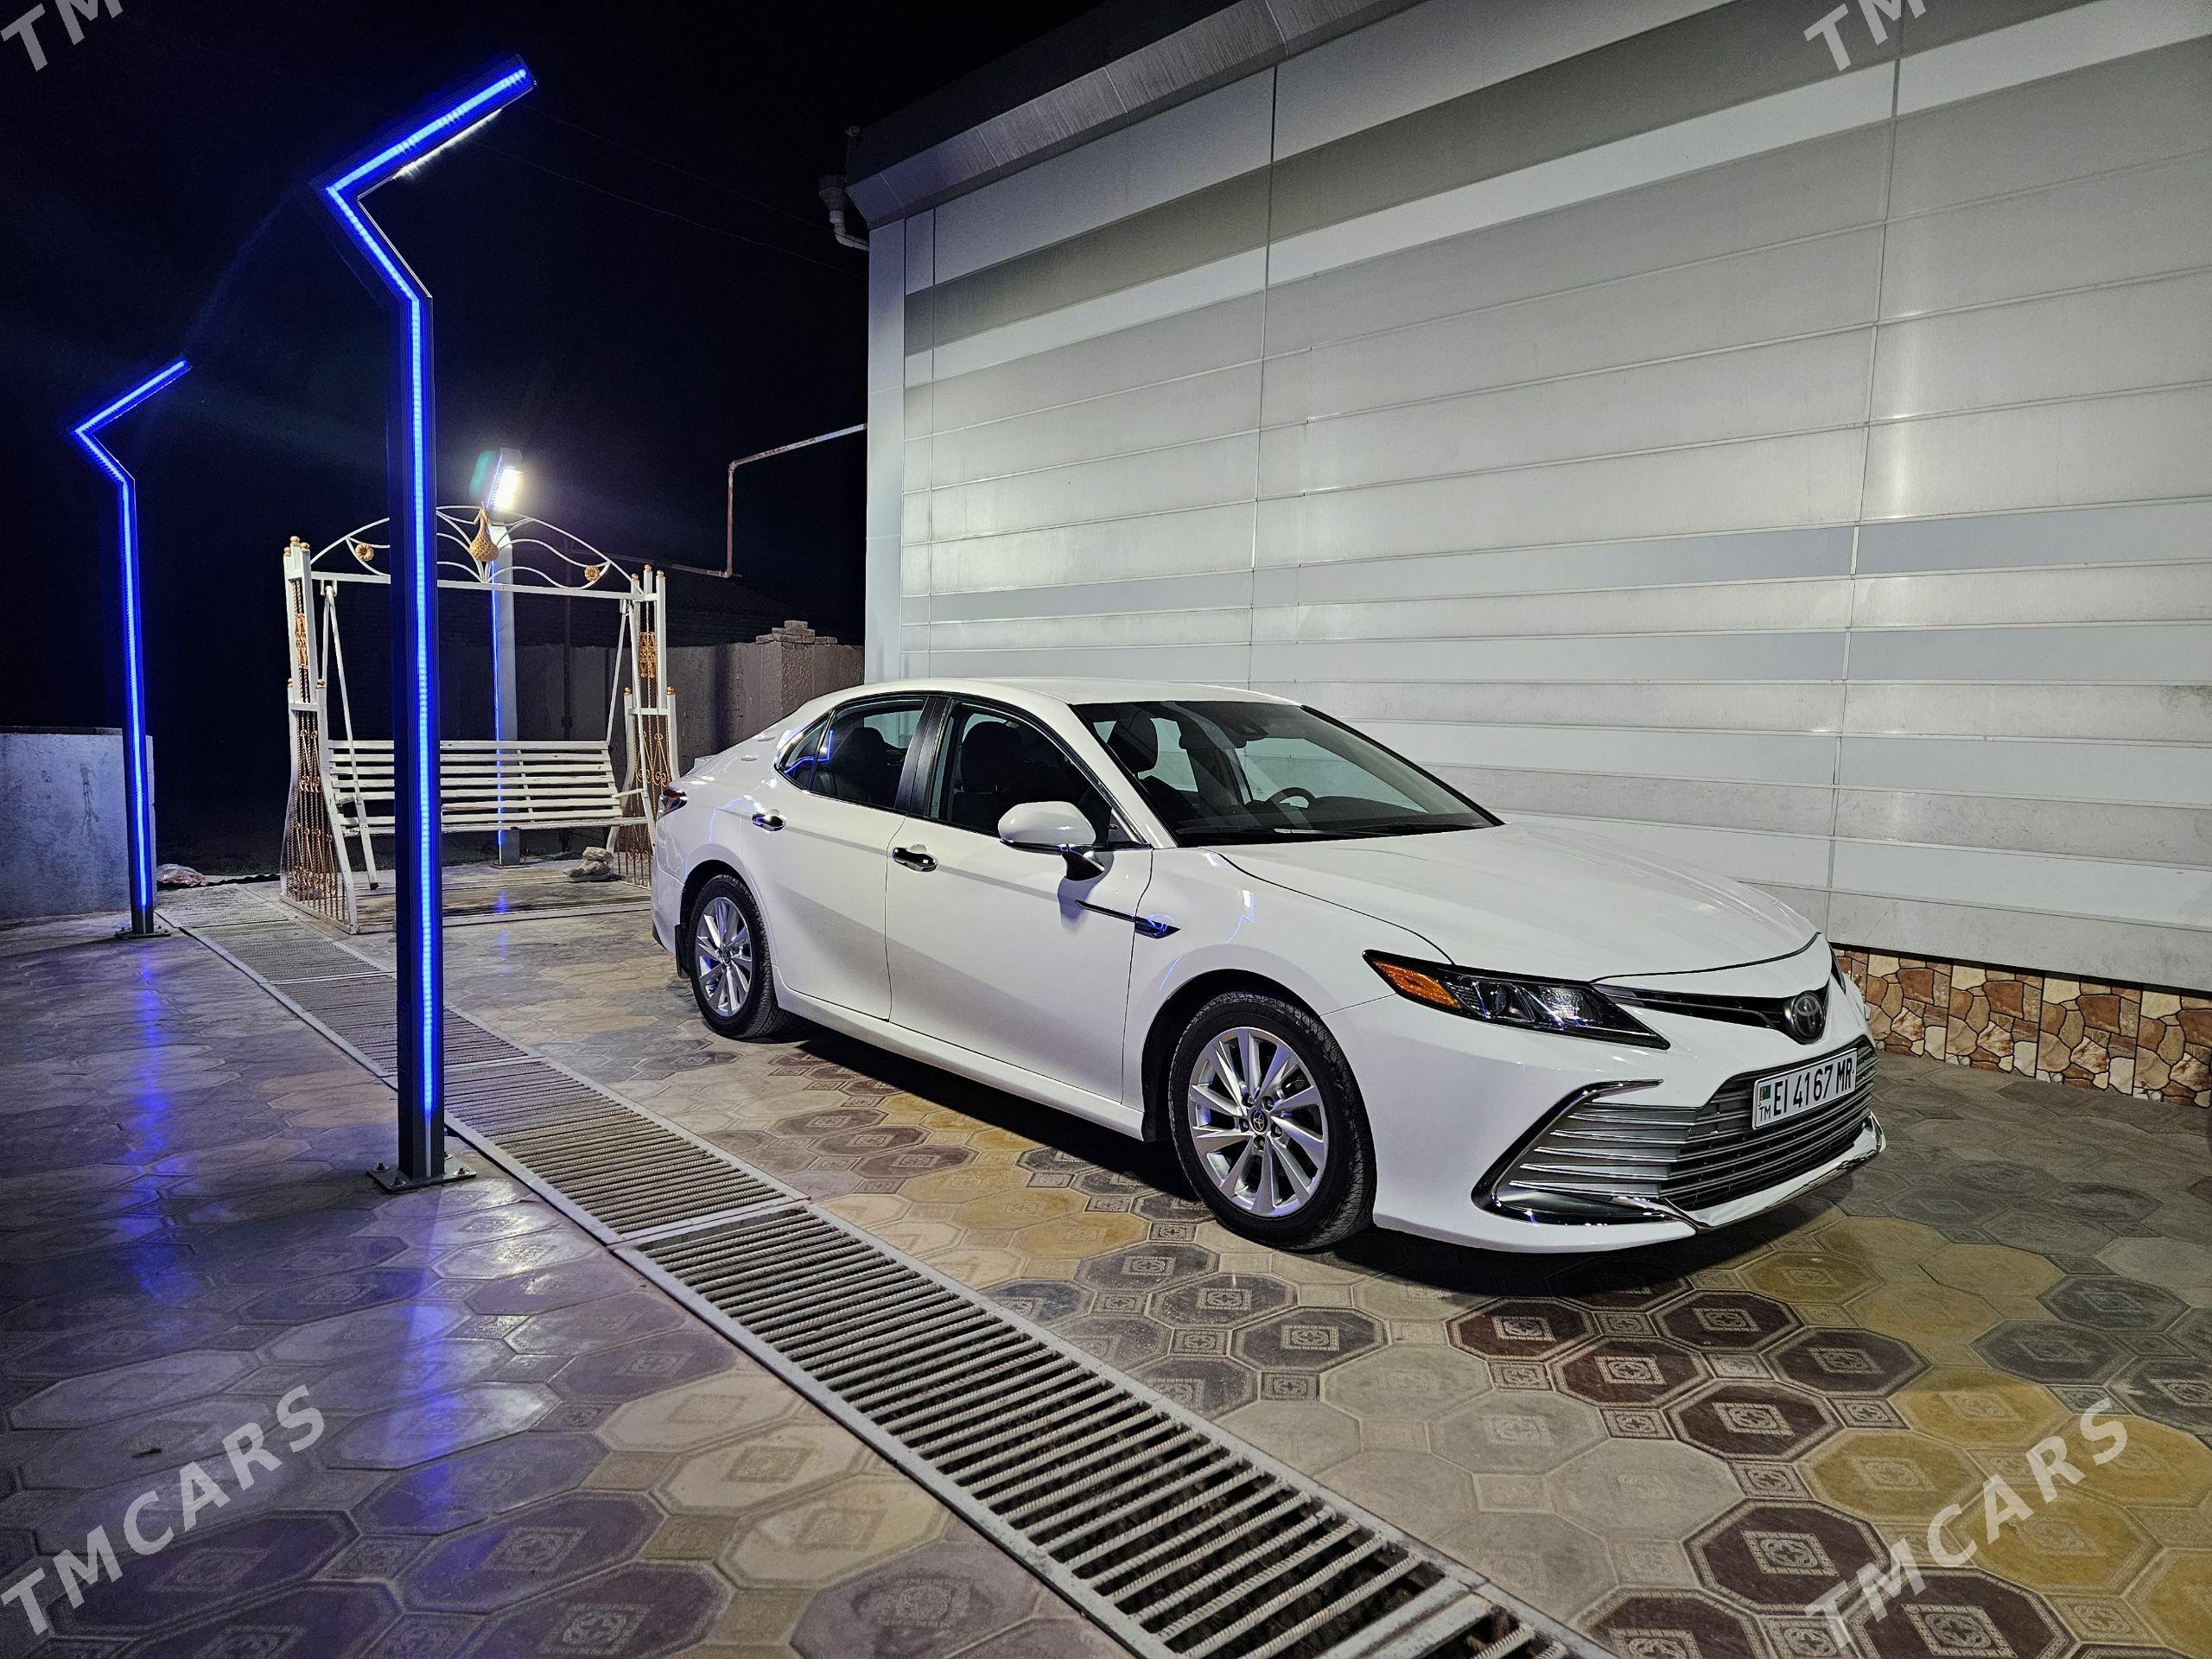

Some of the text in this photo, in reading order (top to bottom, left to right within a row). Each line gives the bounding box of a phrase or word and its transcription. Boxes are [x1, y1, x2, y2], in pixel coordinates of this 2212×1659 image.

[1792, 1065, 1834, 1109] 4167
[1835, 1057, 1853, 1094] MR
[1758, 1103, 1771, 1122] TM
